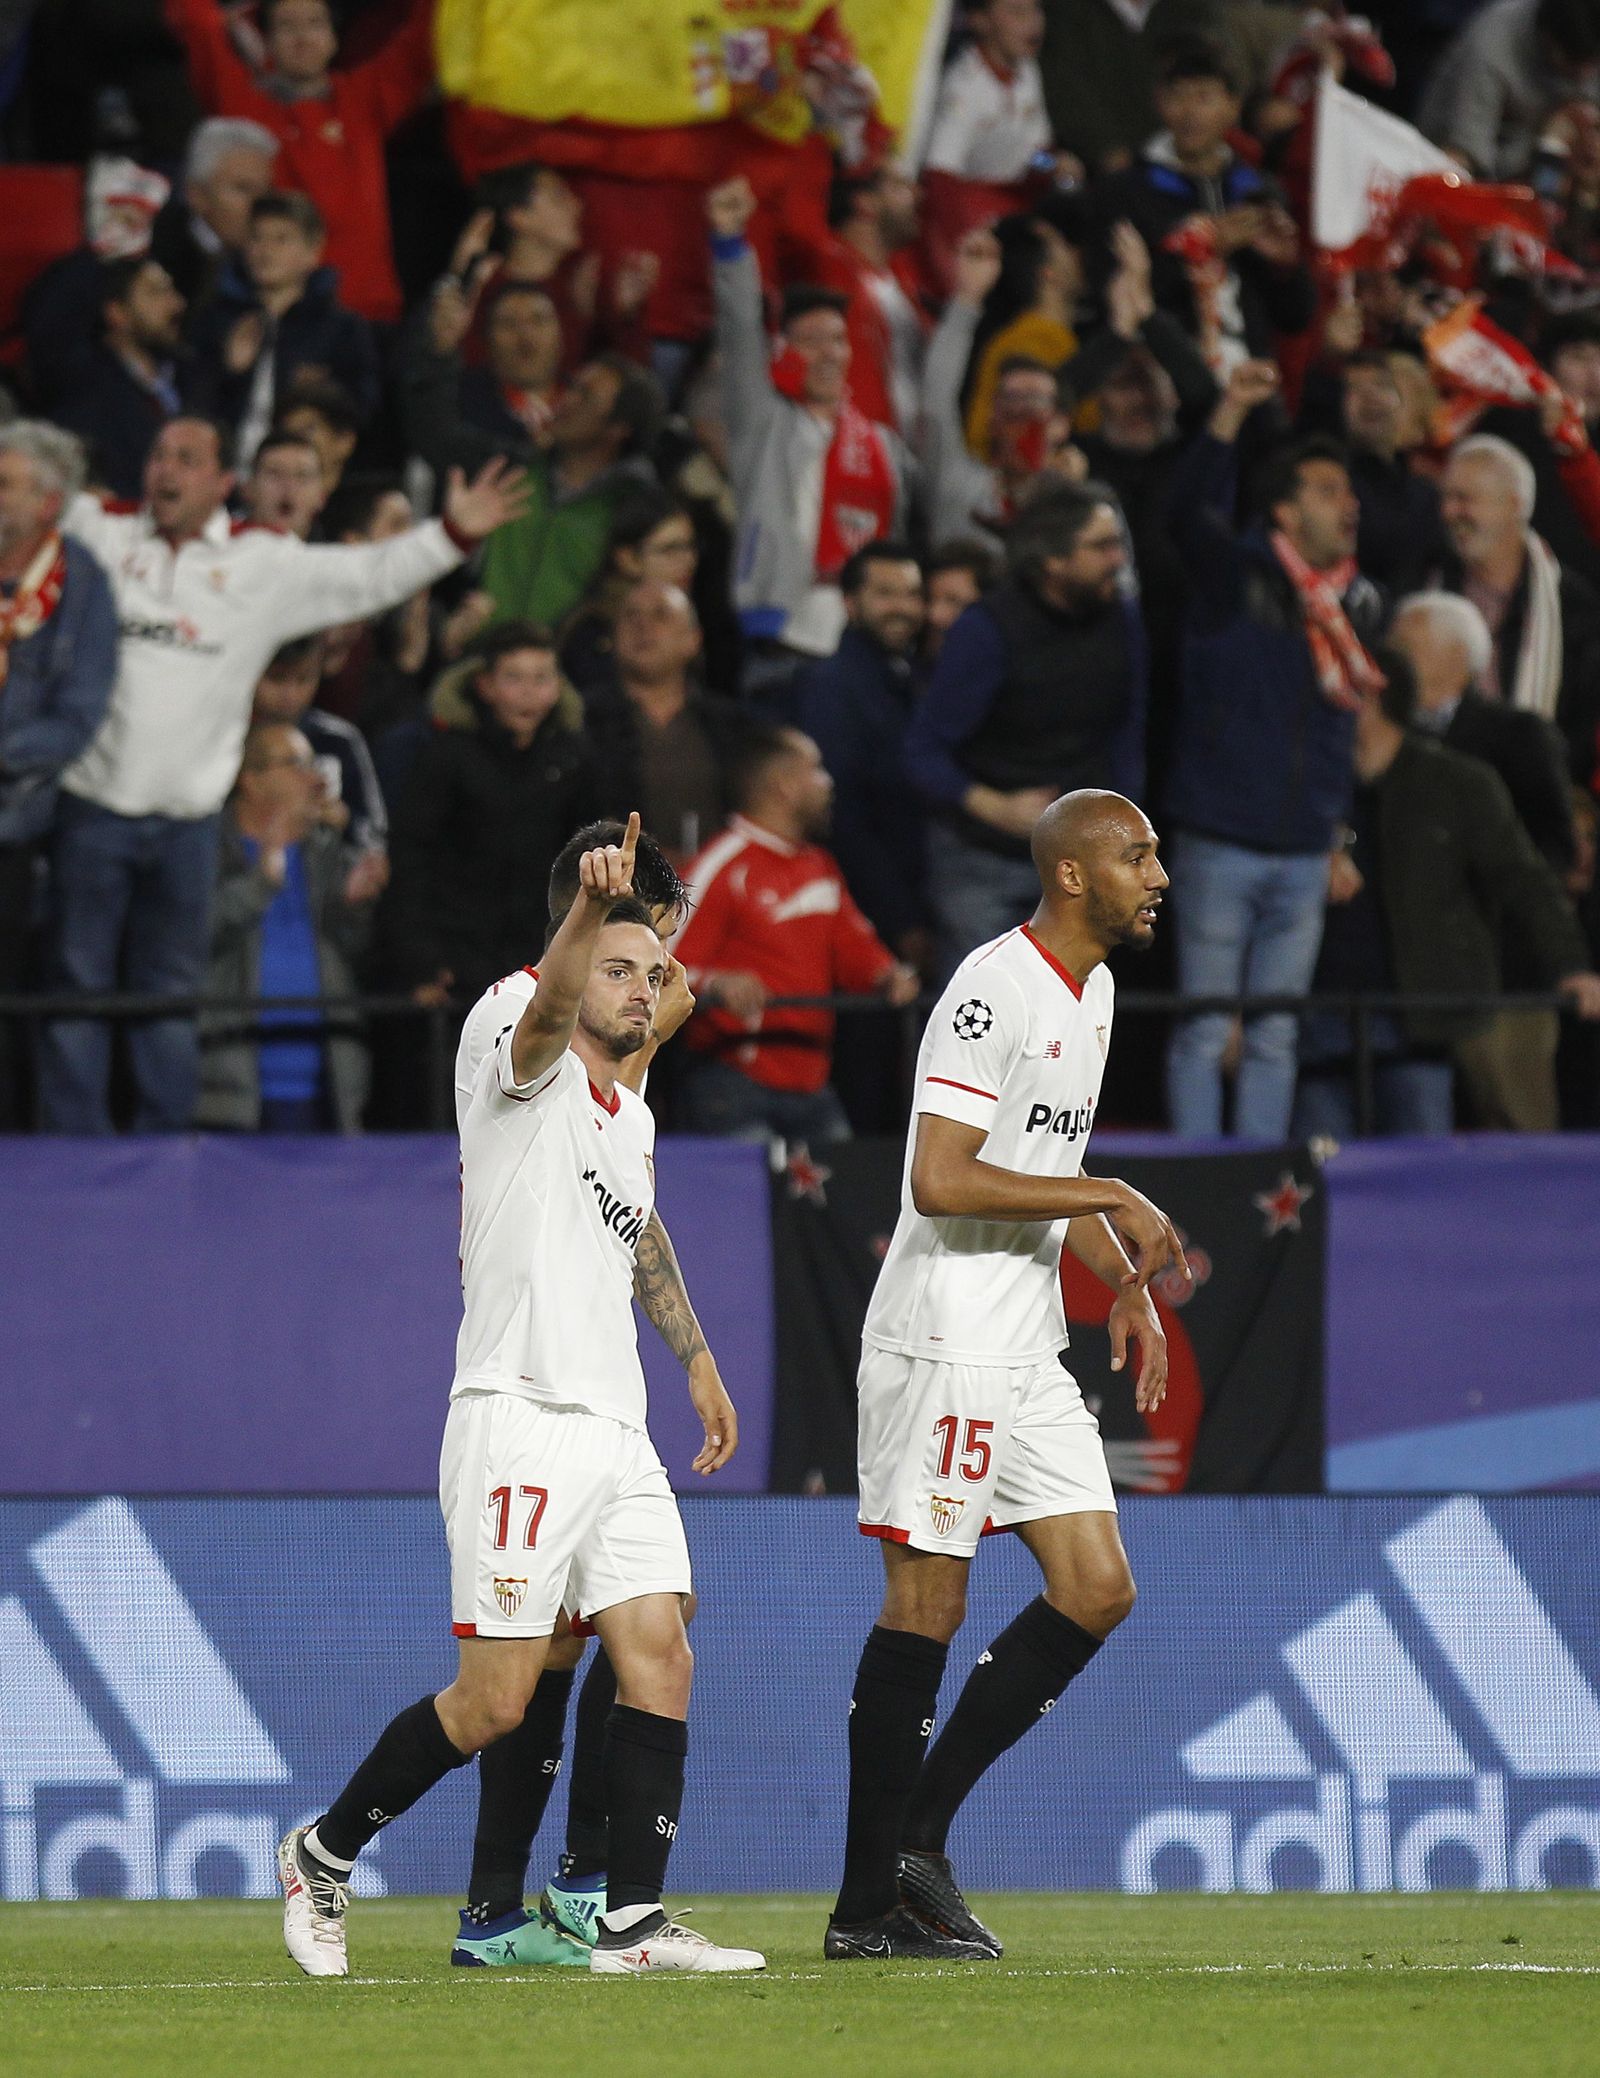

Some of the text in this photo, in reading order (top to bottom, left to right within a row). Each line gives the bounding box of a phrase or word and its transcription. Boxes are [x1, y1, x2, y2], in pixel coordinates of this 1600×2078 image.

[1025, 1096, 1094, 1142] Playti
[933, 1415, 994, 1484] 15
[488, 1485, 548, 1550] 17
